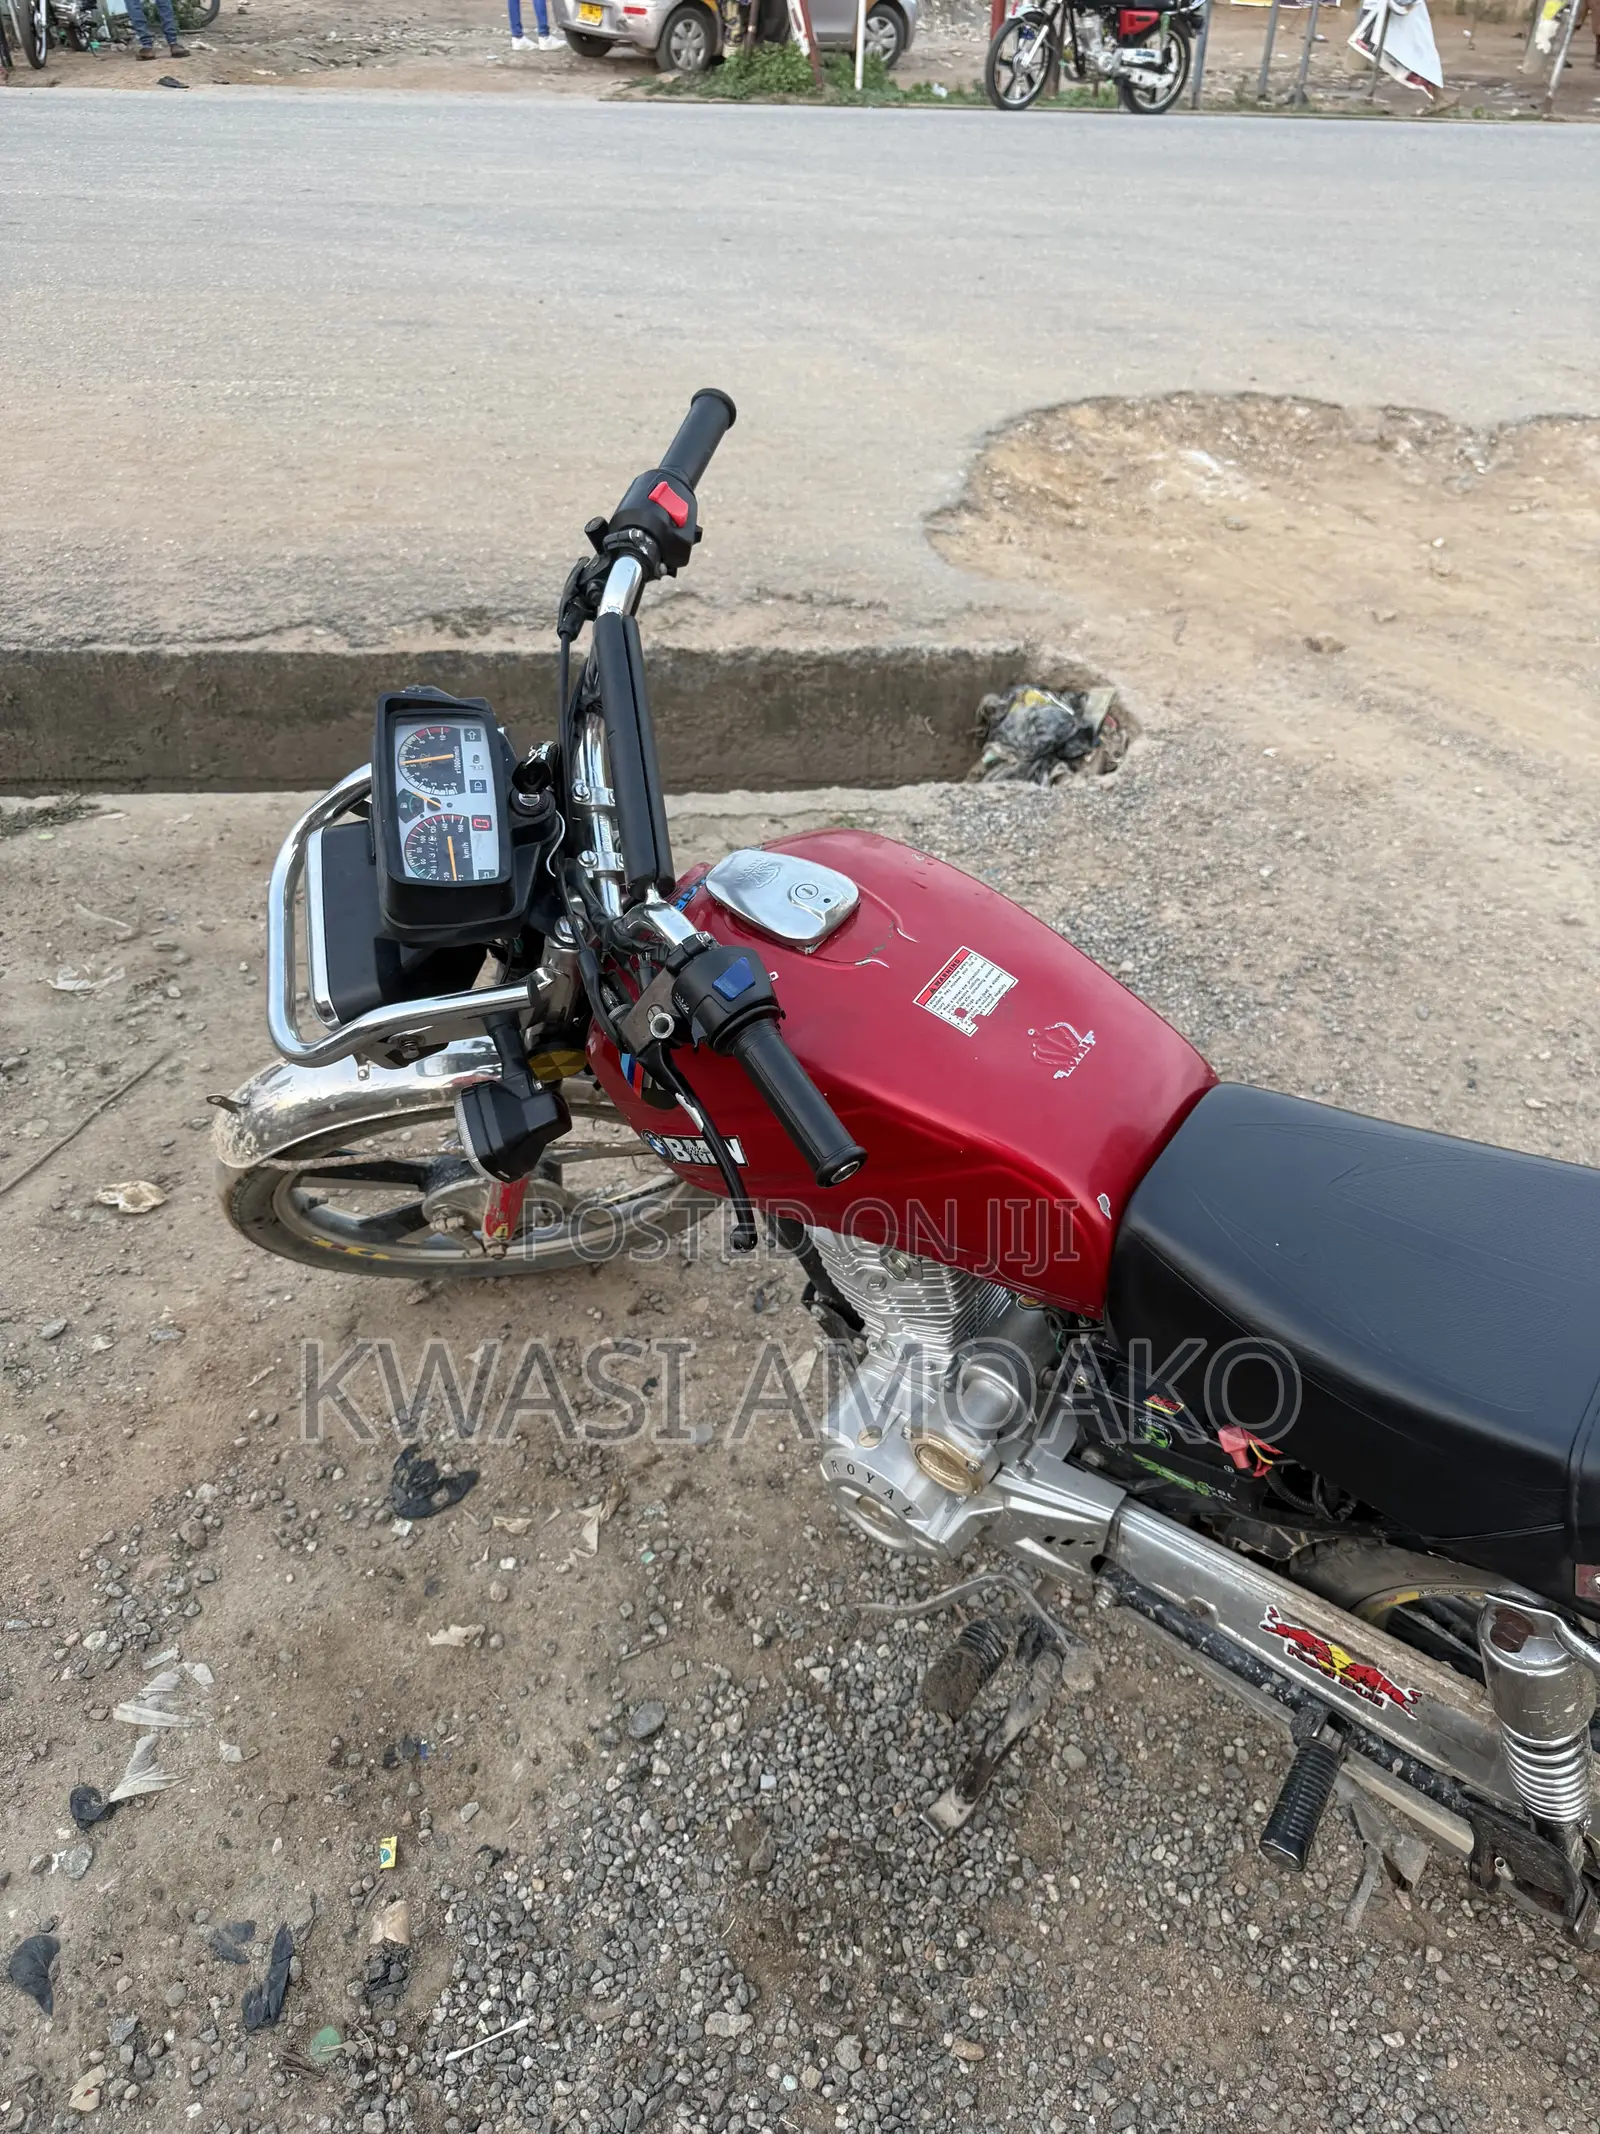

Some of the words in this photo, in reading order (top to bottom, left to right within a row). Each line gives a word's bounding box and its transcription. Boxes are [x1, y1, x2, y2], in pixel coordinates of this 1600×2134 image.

[461, 842, 470, 859] km/h
[934, 958, 961, 987] WARNING
[830, 1460, 913, 1516] ROYAL
